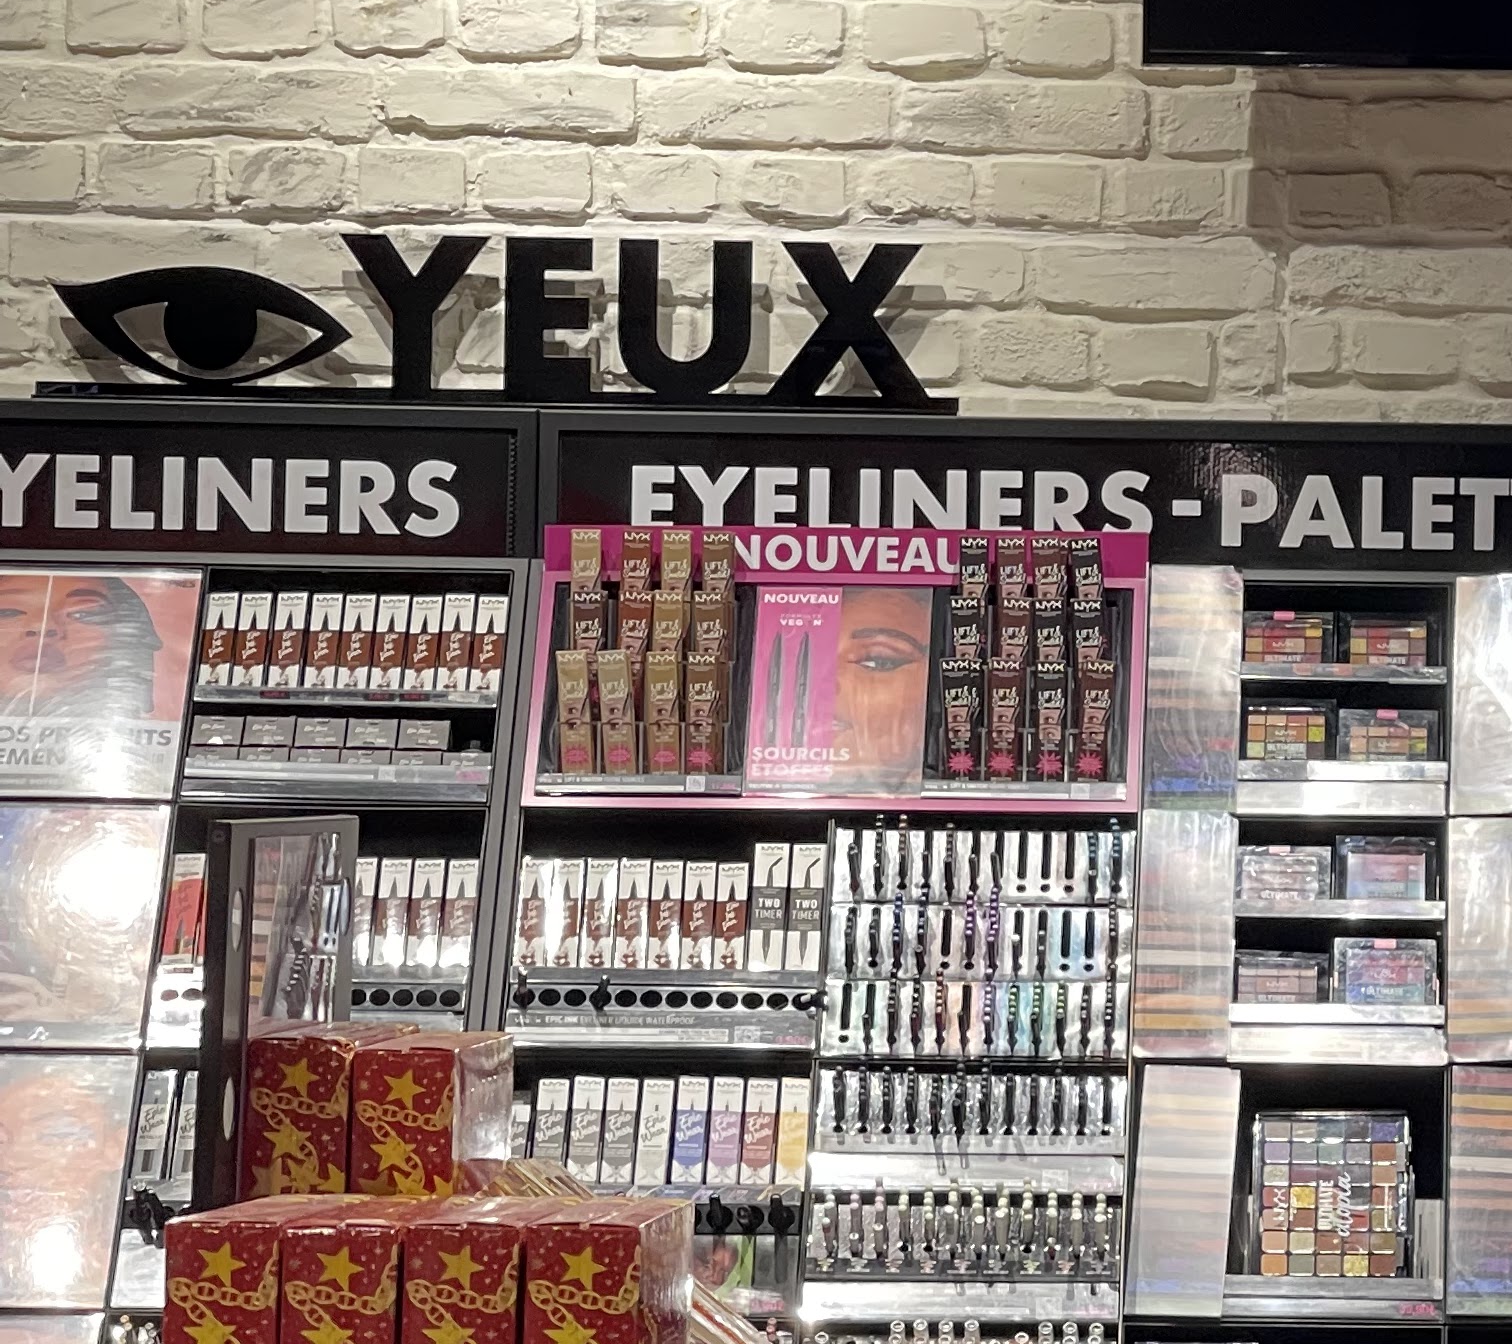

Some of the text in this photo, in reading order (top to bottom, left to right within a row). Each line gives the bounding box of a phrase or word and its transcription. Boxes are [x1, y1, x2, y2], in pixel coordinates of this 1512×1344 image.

[340, 233, 940, 401] YEUX
[624, 532, 651, 542] NYX
[663, 533, 691, 543] NYX
[703, 533, 730, 543] NYX
[961, 538, 988, 548] NYX
[998, 538, 1025, 549] NYX
[1032, 538, 1059, 548] NYX
[1071, 538, 1098, 550] NYX
[734, 534, 960, 575] NOUVEAU
[574, 592, 601, 601] NYX
[625, 591, 652, 601] NYX
[656, 592, 683, 603] NYX
[695, 593, 722, 603] NYX
[763, 593, 840, 605] NOUVEAU
[951, 598, 978, 609] NYX
[1003, 598, 1030, 609] NYX
[1035, 599, 1062, 609] NYX
[1074, 599, 1101, 611] NYX
[649, 653, 675, 663] NYX
[688, 654, 716, 664] NYX
[942, 660, 969, 671] NYX
[993, 659, 1020, 671] NYX
[1037, 661, 1065, 673] NYX
[1087, 661, 1114, 673] NYX
[751, 746, 850, 763] SOURCILS
[758, 897, 781, 909] TWO
[795, 898, 818, 910] TWO
[754, 908, 783, 920] TIMER
[791, 909, 820, 921] TIMER
